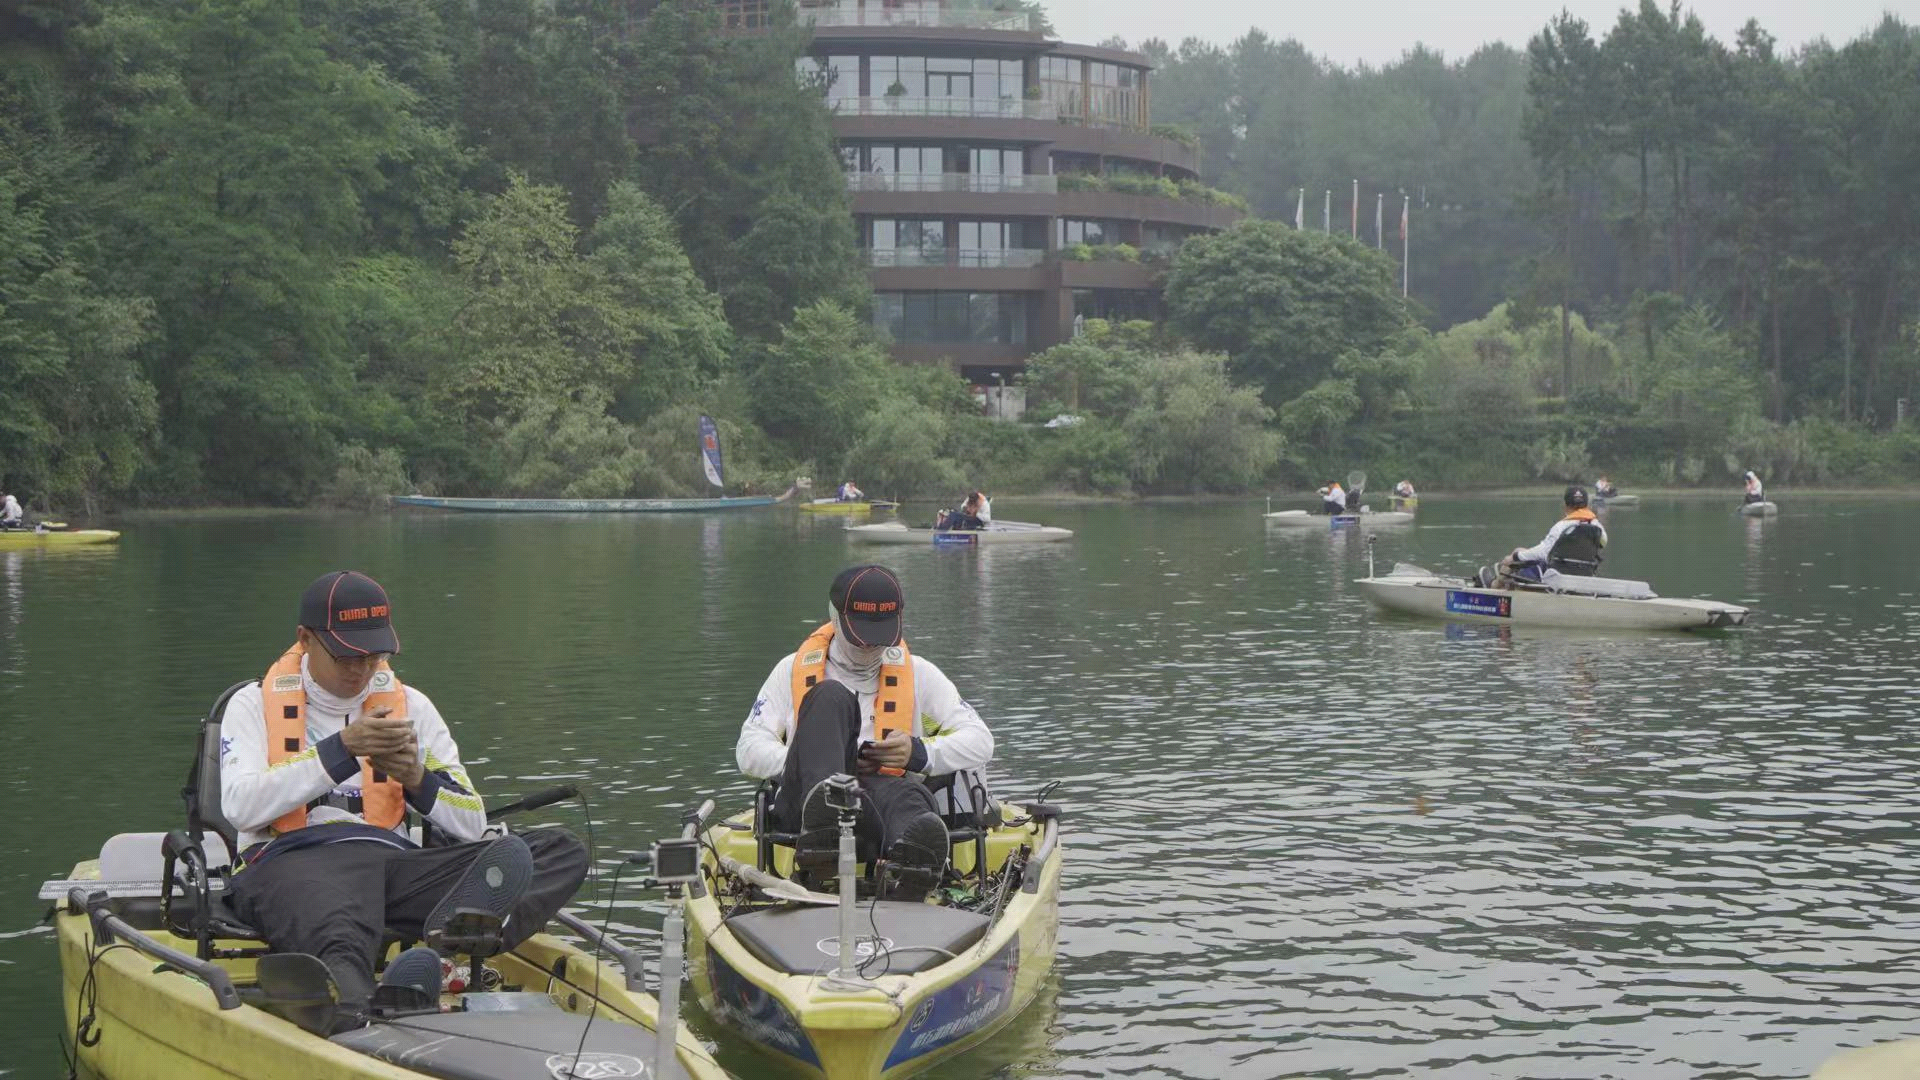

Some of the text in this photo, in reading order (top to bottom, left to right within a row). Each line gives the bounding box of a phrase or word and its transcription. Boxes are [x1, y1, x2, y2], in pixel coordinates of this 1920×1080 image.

[854, 602, 896, 612] CHINA OPEN
[339, 608, 368, 621] CHINA
